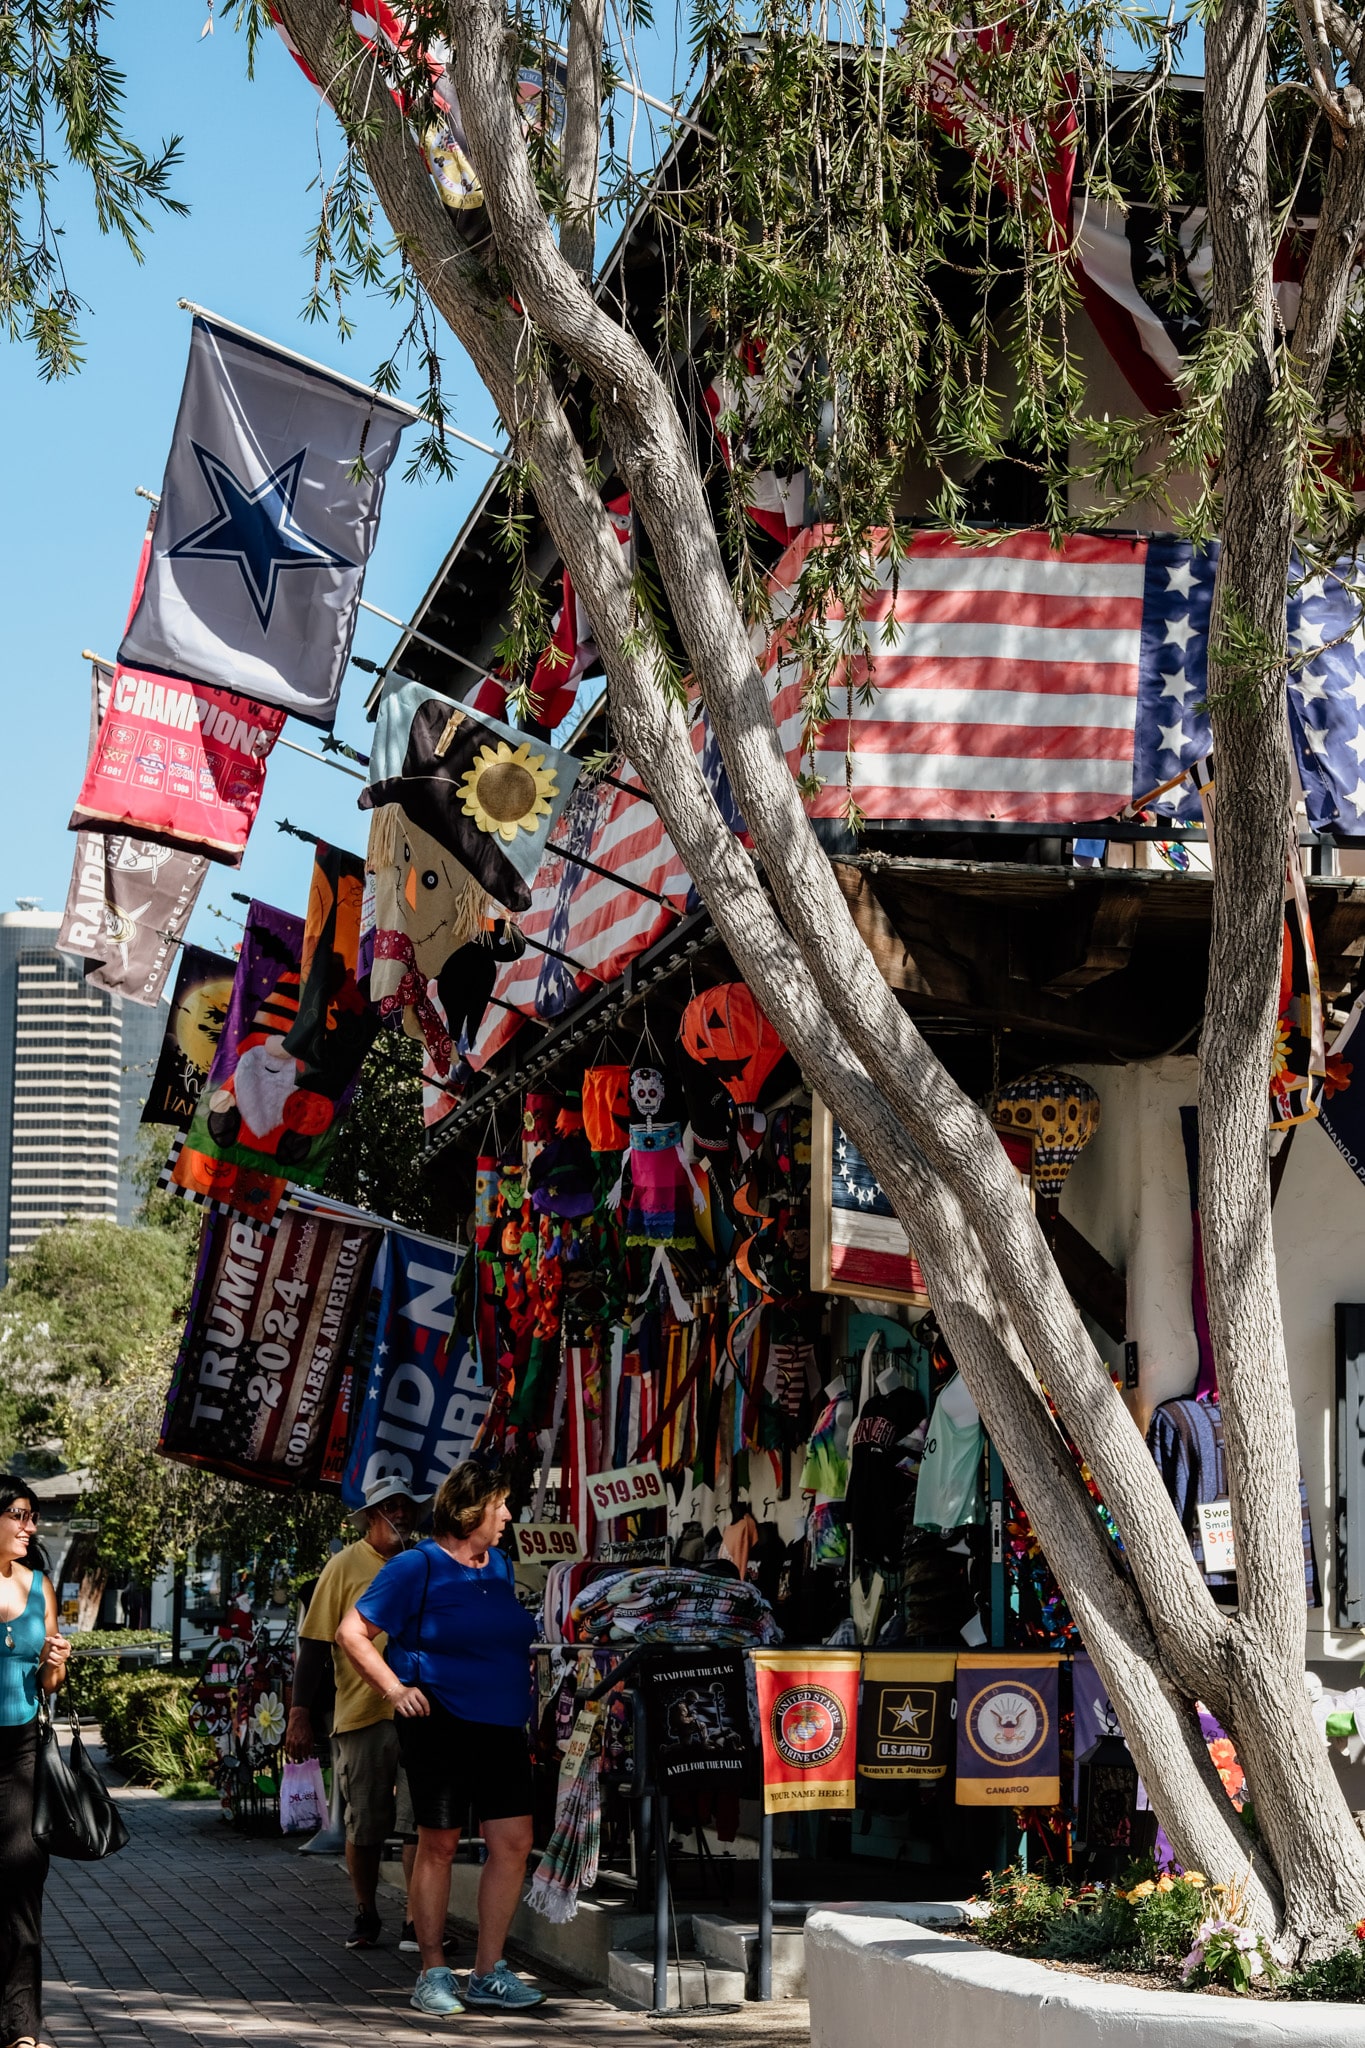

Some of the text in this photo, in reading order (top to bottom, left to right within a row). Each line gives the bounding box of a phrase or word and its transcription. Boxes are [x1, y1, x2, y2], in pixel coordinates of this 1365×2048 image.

[113, 674, 277, 757] CHAMPIONS
[102, 765, 123, 776] 1981
[139, 774, 159, 786] 1984
[144, 856, 201, 993] COMMMENT TO
[190, 1221, 265, 1428] TRUMP
[248, 1278, 309, 1409] 2024
[285, 1237, 363, 1467] GOD BLESS AMERICA
[593, 1472, 661, 1509] $19.99
[519, 1529, 577, 1557] $9.99
[652, 1665, 734, 1682] STAND FOR THE FLAG
[777, 1691, 841, 1723] UNITED STATES
[778, 1735, 840, 1762] MARINE CORPS
[667, 1760, 743, 1776] KNEEL FOR THE FALLEN
[863, 1766, 895, 1775] RODNEY
[906, 1766, 943, 1775] JOHNSON
[770, 1791, 790, 1801] YOUR
[791, 1789, 816, 1798] NAME
[985, 1785, 1030, 1795] CANARGO
